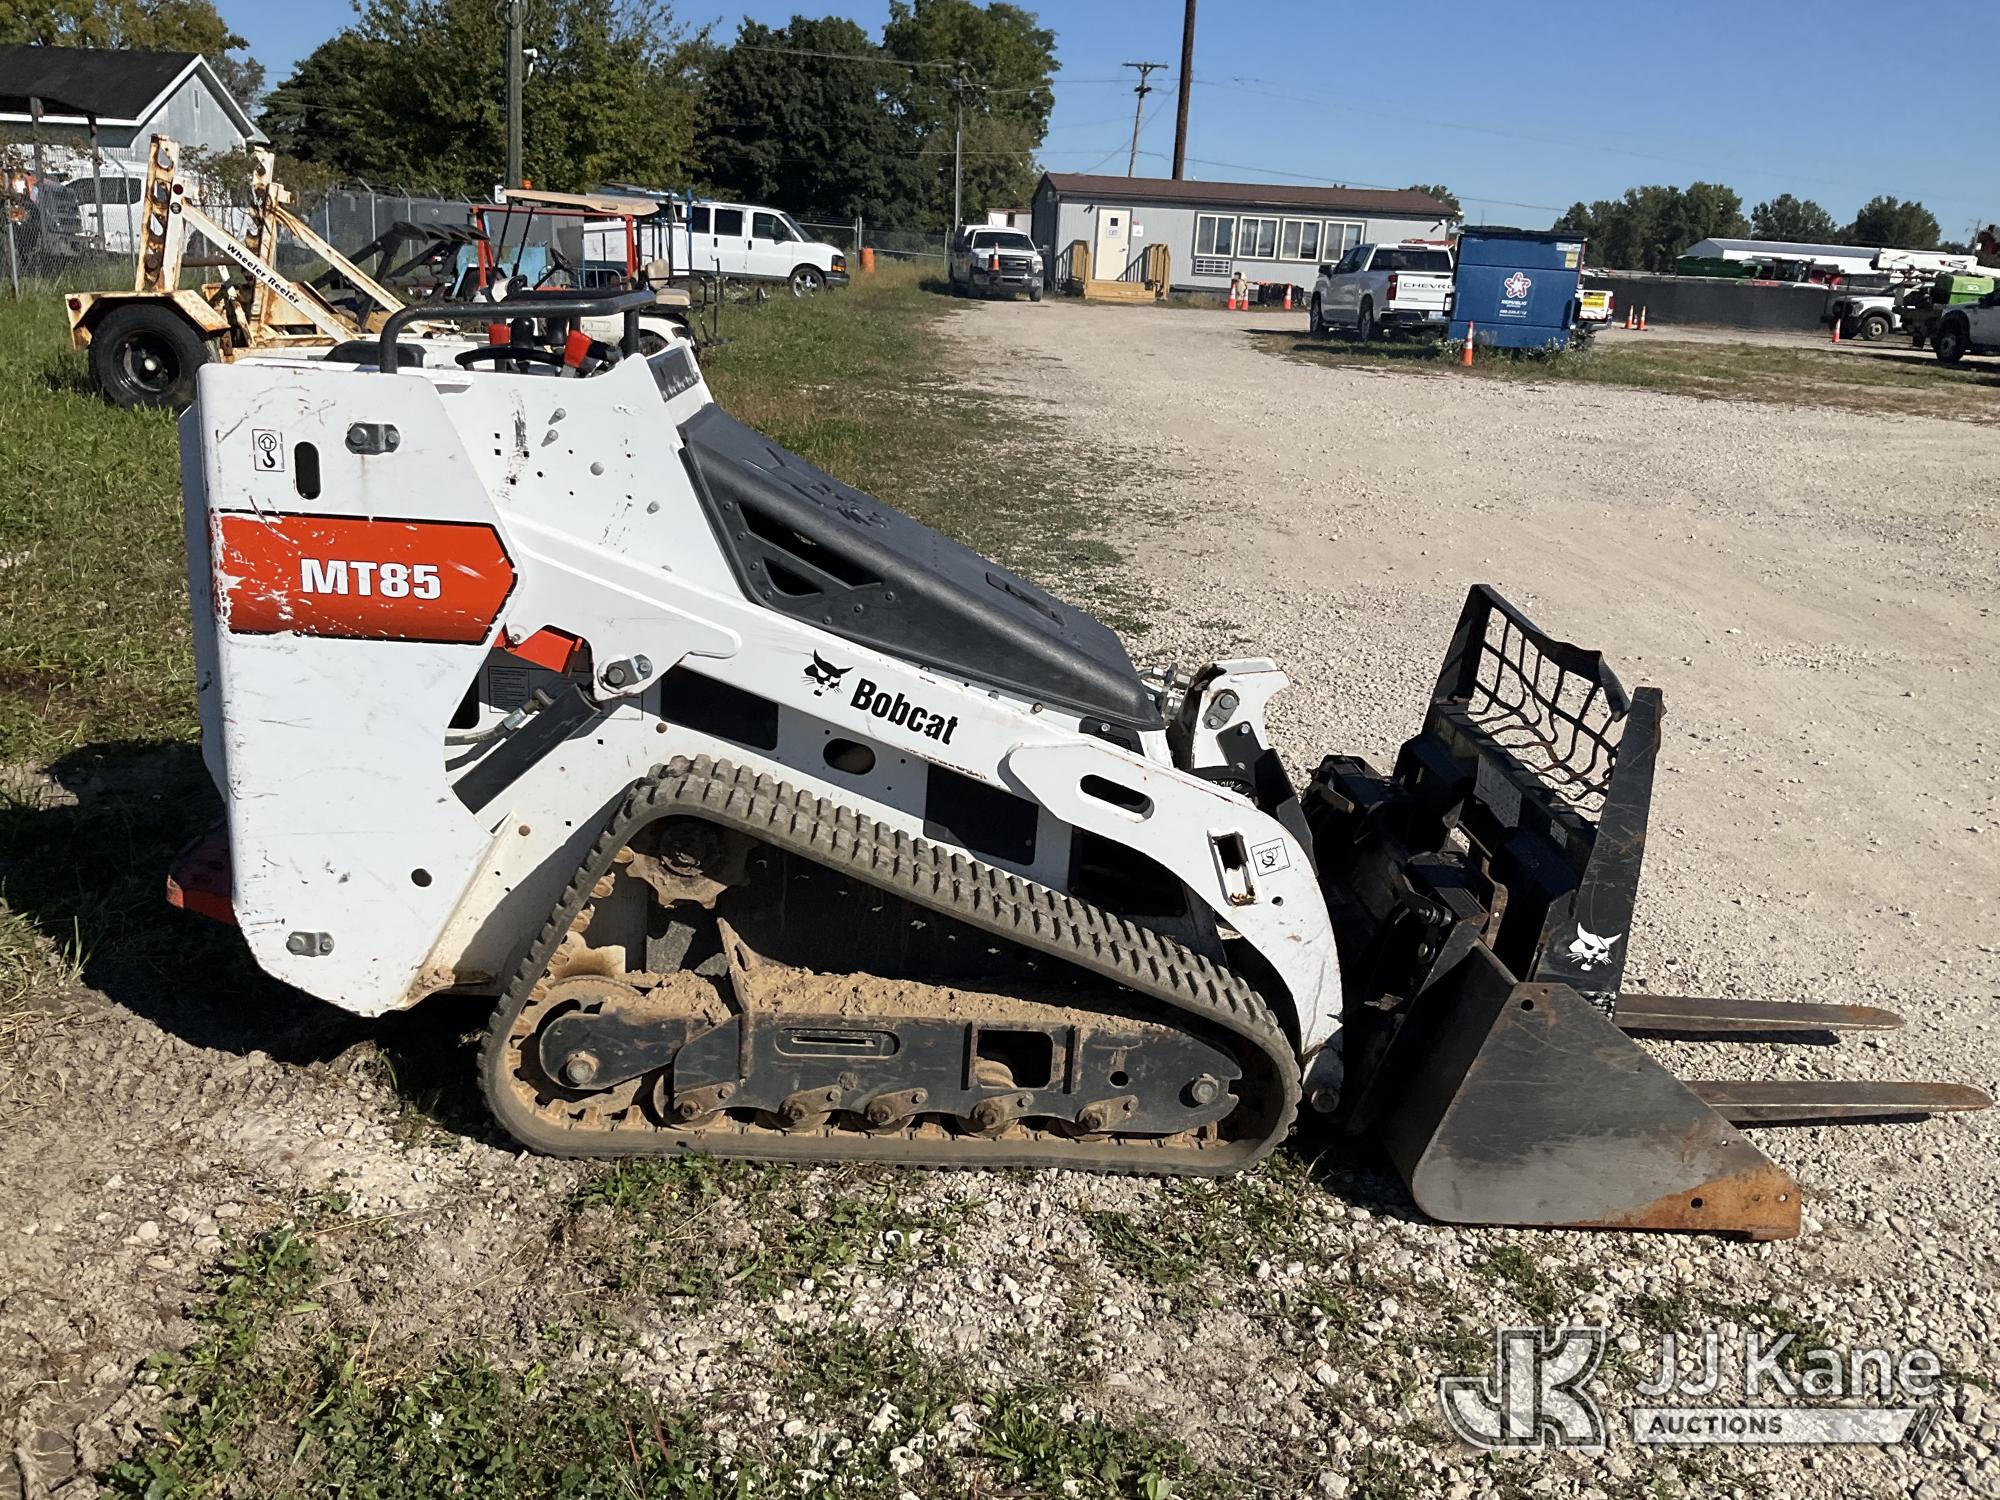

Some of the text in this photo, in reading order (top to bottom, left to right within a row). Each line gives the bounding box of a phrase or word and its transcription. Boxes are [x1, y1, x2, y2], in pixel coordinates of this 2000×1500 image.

[227, 243, 299, 304] Wheeler Reeler
[300, 558, 441, 600] MT85
[850, 678, 958, 745] Bobcat
